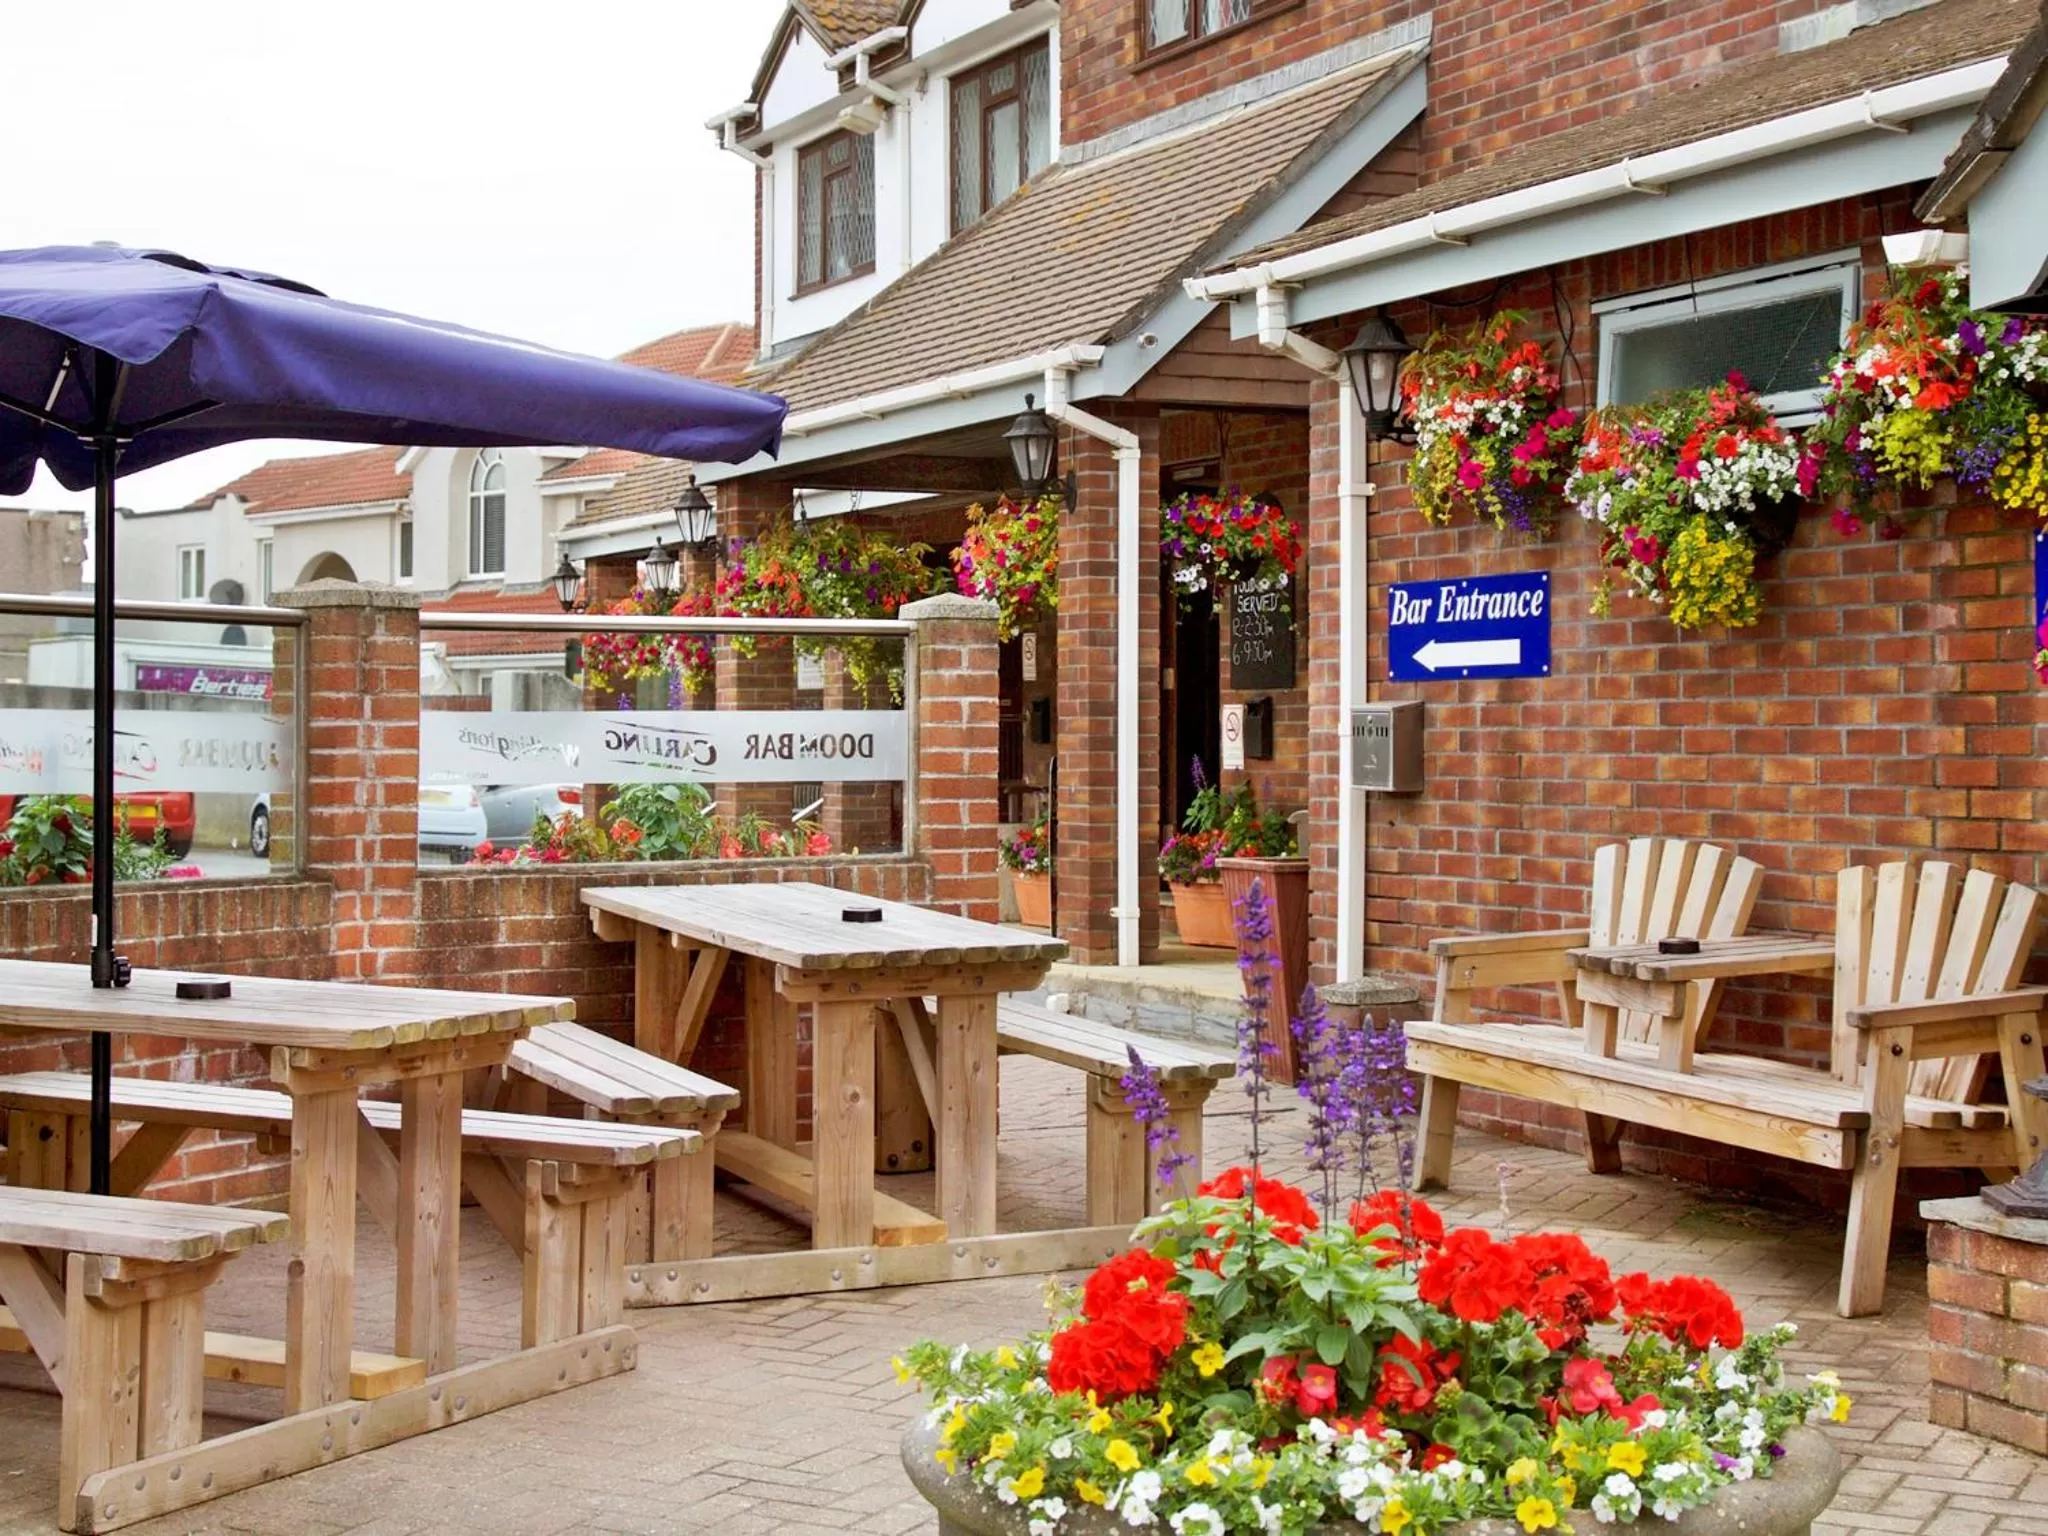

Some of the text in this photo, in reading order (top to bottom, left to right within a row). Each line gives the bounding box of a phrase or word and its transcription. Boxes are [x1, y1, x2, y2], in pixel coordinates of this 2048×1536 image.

[1237, 593, 1278, 616] SERVED
[1391, 586, 1544, 625] Bar Entrance
